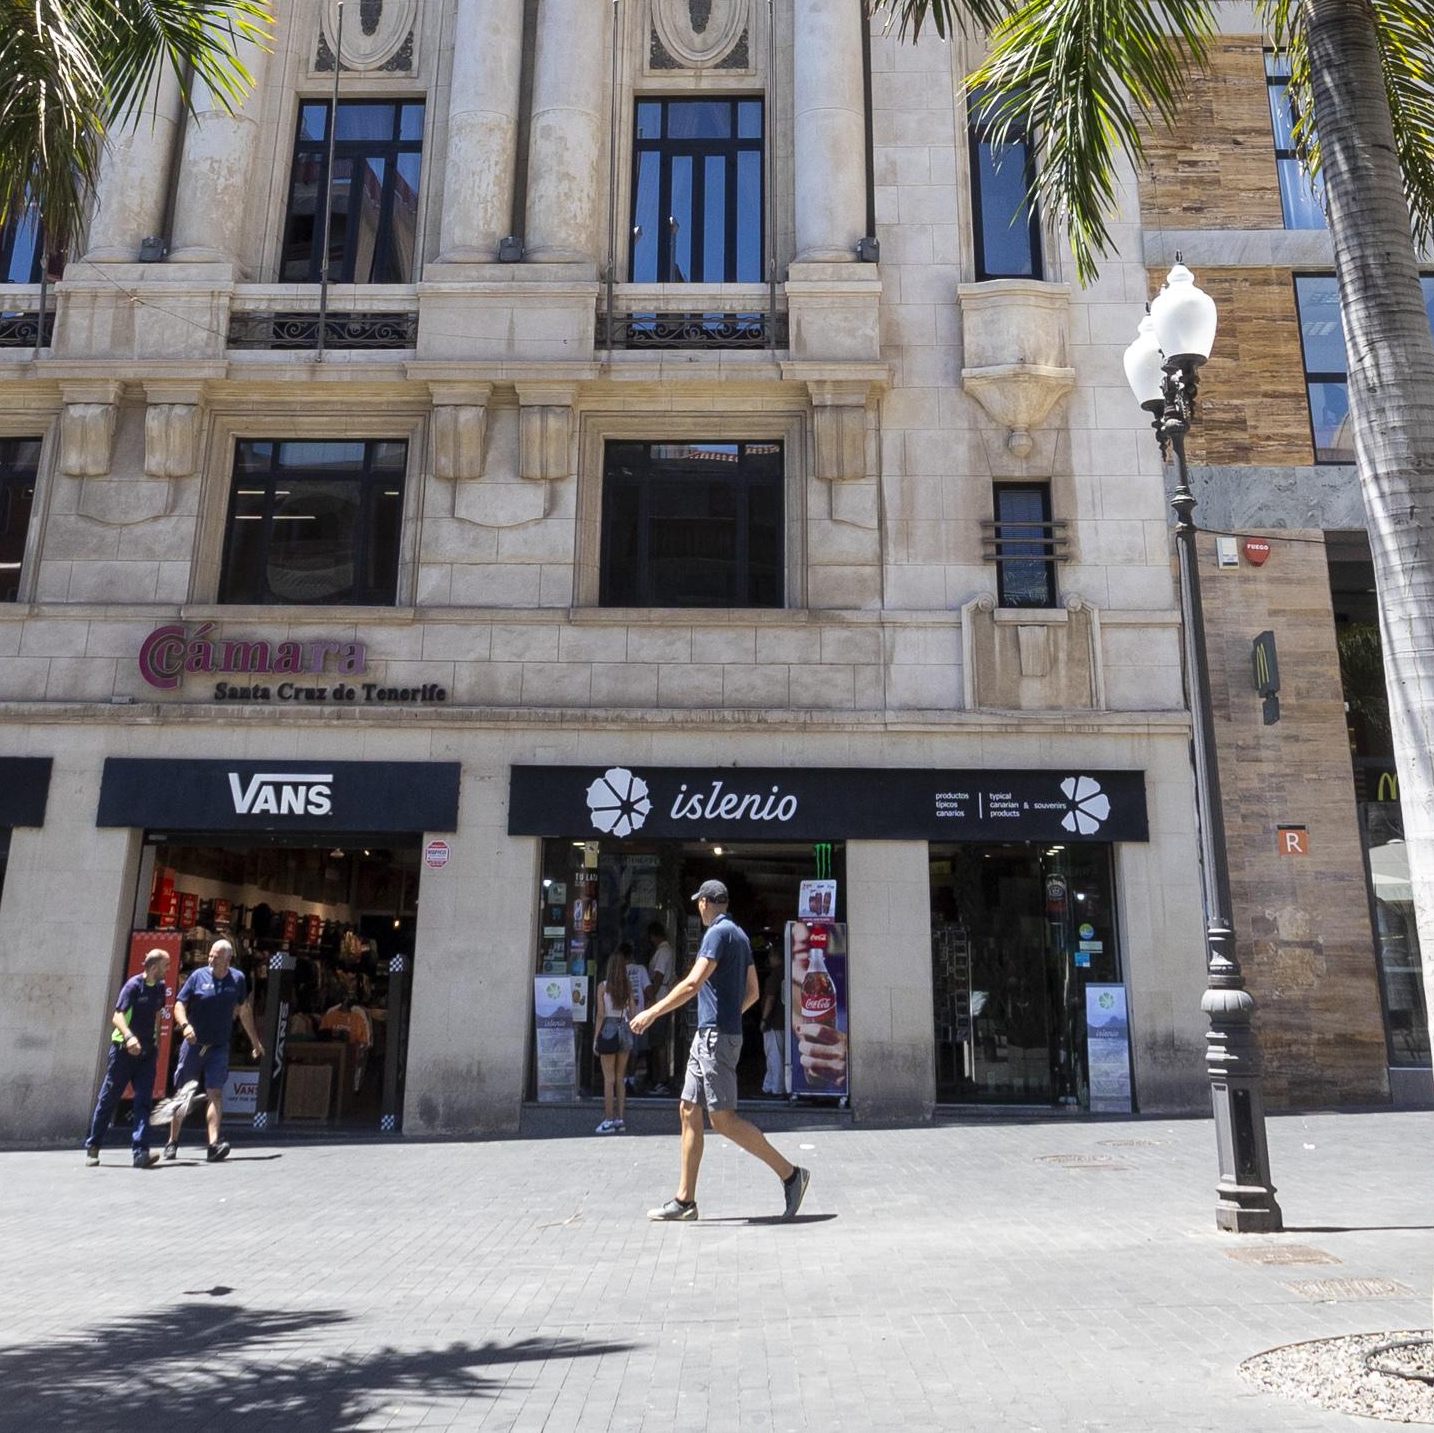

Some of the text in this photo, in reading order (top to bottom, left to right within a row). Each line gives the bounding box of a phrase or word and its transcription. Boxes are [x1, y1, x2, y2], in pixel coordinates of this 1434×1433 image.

[214, 682, 447, 702] Santa Cruz de Tenerife
[228, 772, 333, 816] VANS
[670, 781, 798, 822] islenio
[935, 792, 969, 800] productos
[989, 792, 1012, 801] typical
[989, 801, 1067, 810] canarian & souvenirs
[990, 810, 1021, 818] products
[1285, 832, 1304, 853] R
[272, 1001, 289, 1079] VANS
